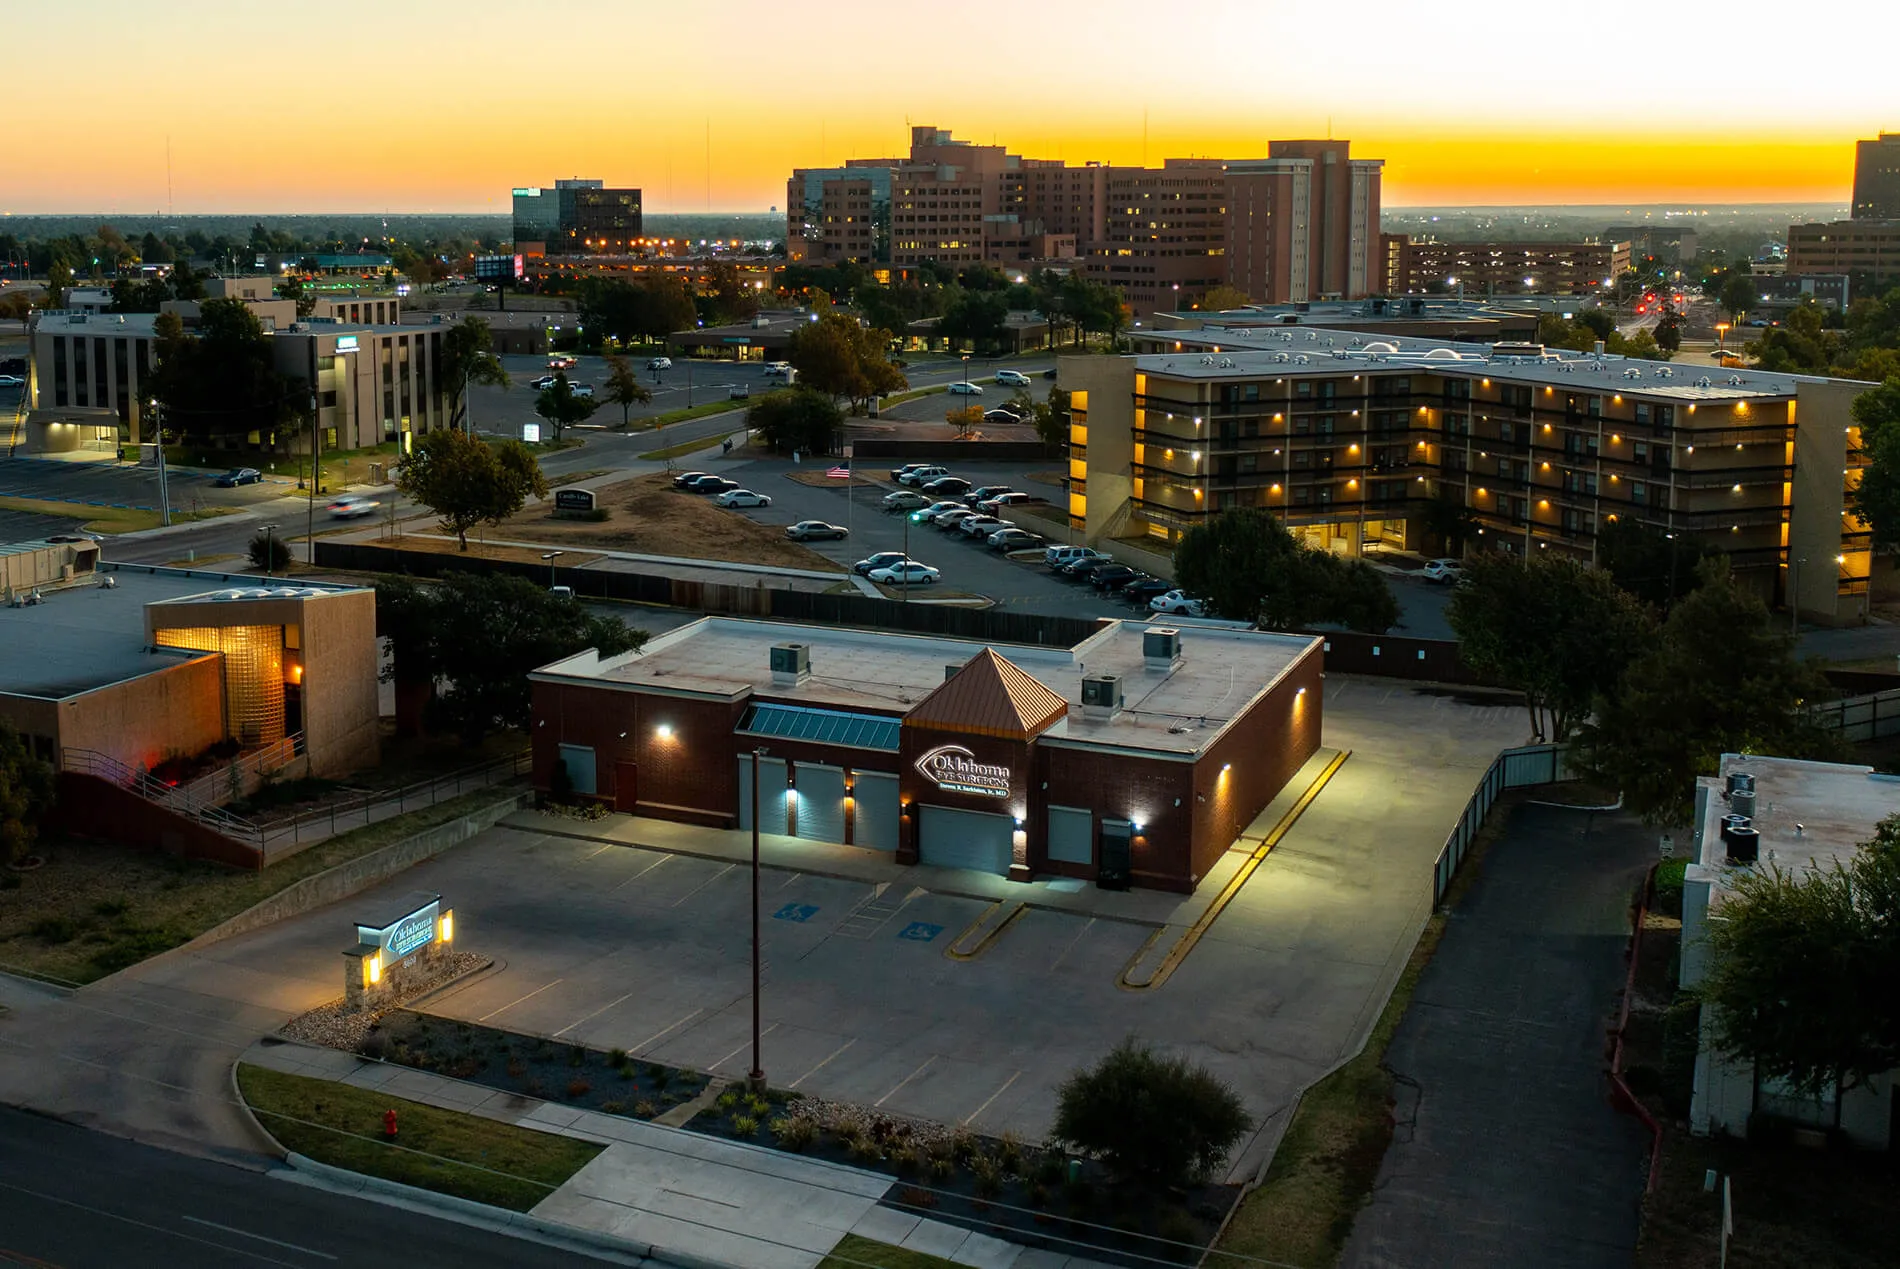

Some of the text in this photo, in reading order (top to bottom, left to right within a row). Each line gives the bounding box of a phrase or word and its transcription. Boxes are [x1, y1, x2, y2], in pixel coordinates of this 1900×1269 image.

[931, 755, 1010, 778] Oklahoma
[935, 769, 1009, 788] EYE SURGEONS
[395, 917, 432, 943] Oklahoma
